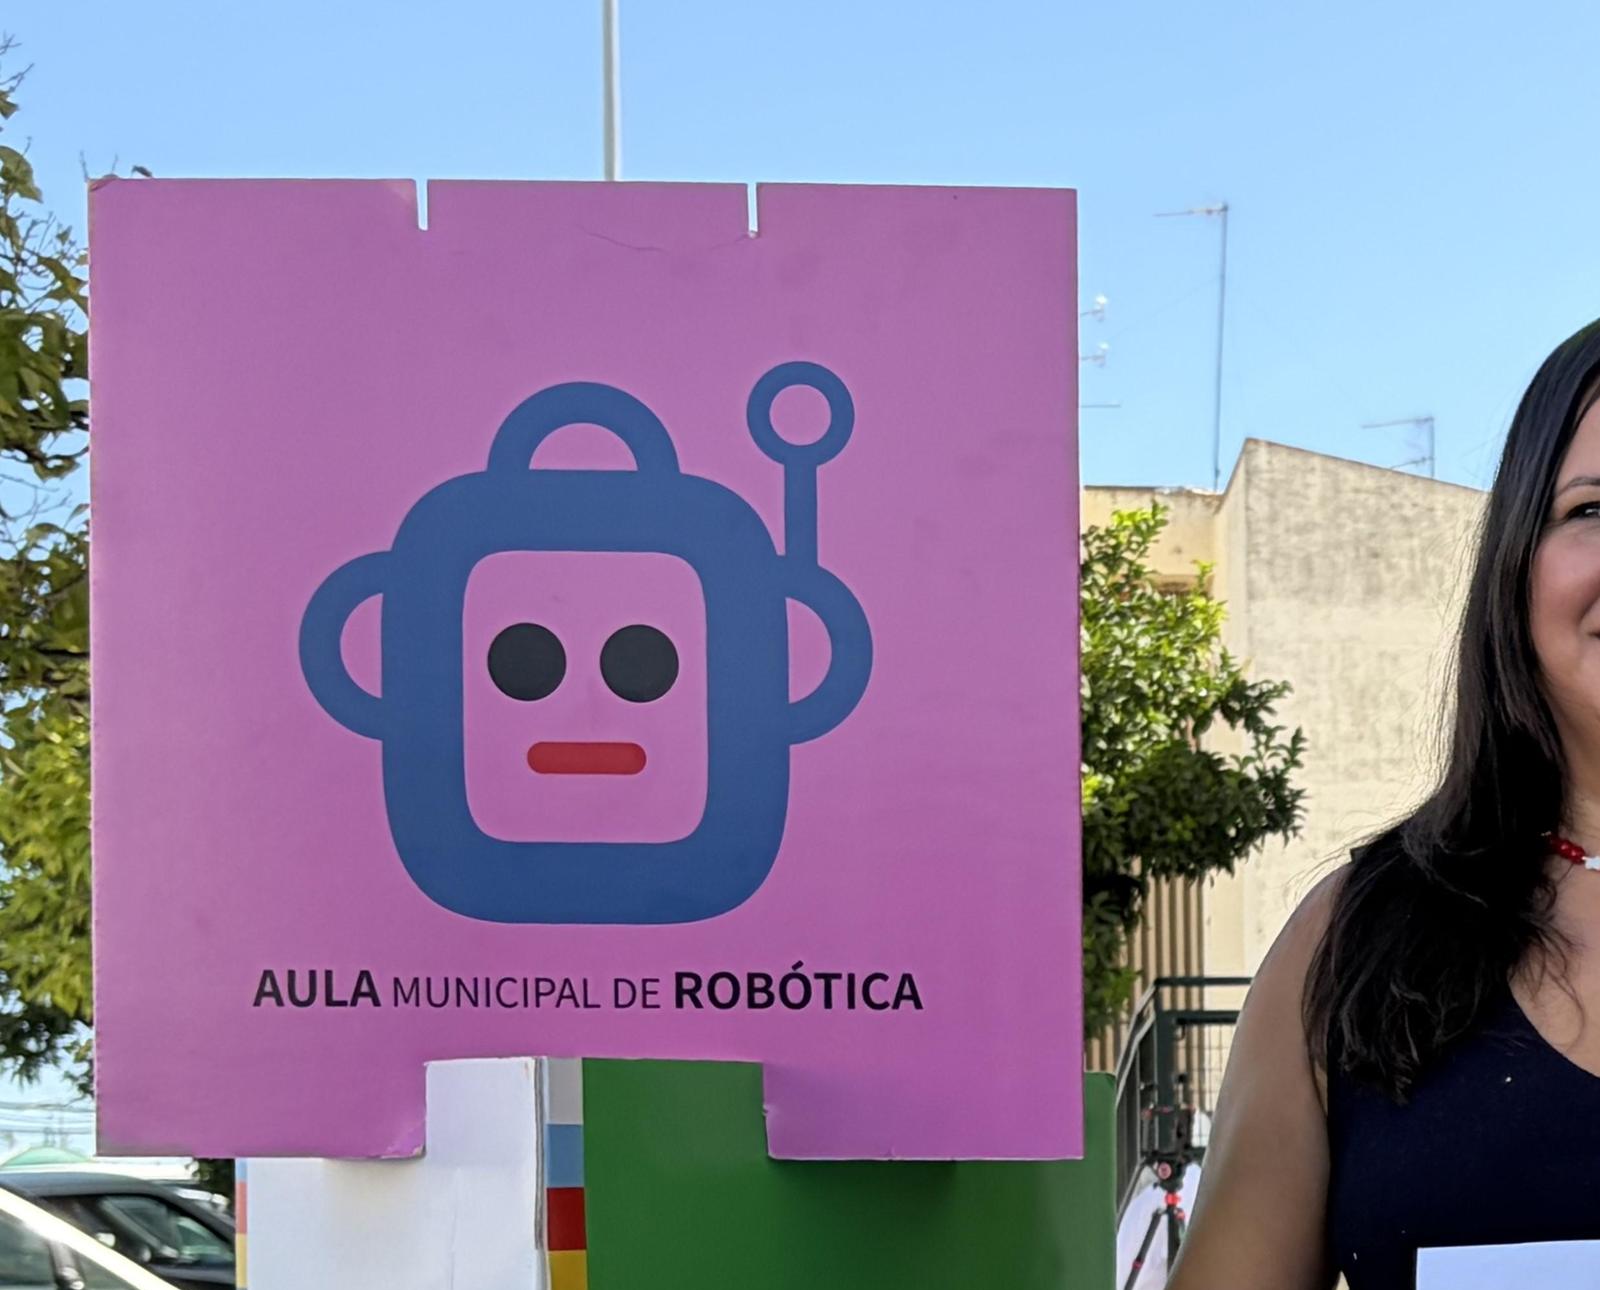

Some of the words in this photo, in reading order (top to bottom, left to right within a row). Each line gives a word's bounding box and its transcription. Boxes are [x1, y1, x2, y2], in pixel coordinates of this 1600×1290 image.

[253, 968, 381, 1008] AULA
[392, 976, 601, 1009] MUNICIPAL
[613, 977, 661, 1009] DE
[673, 961, 924, 1011] ROBÓTICA
